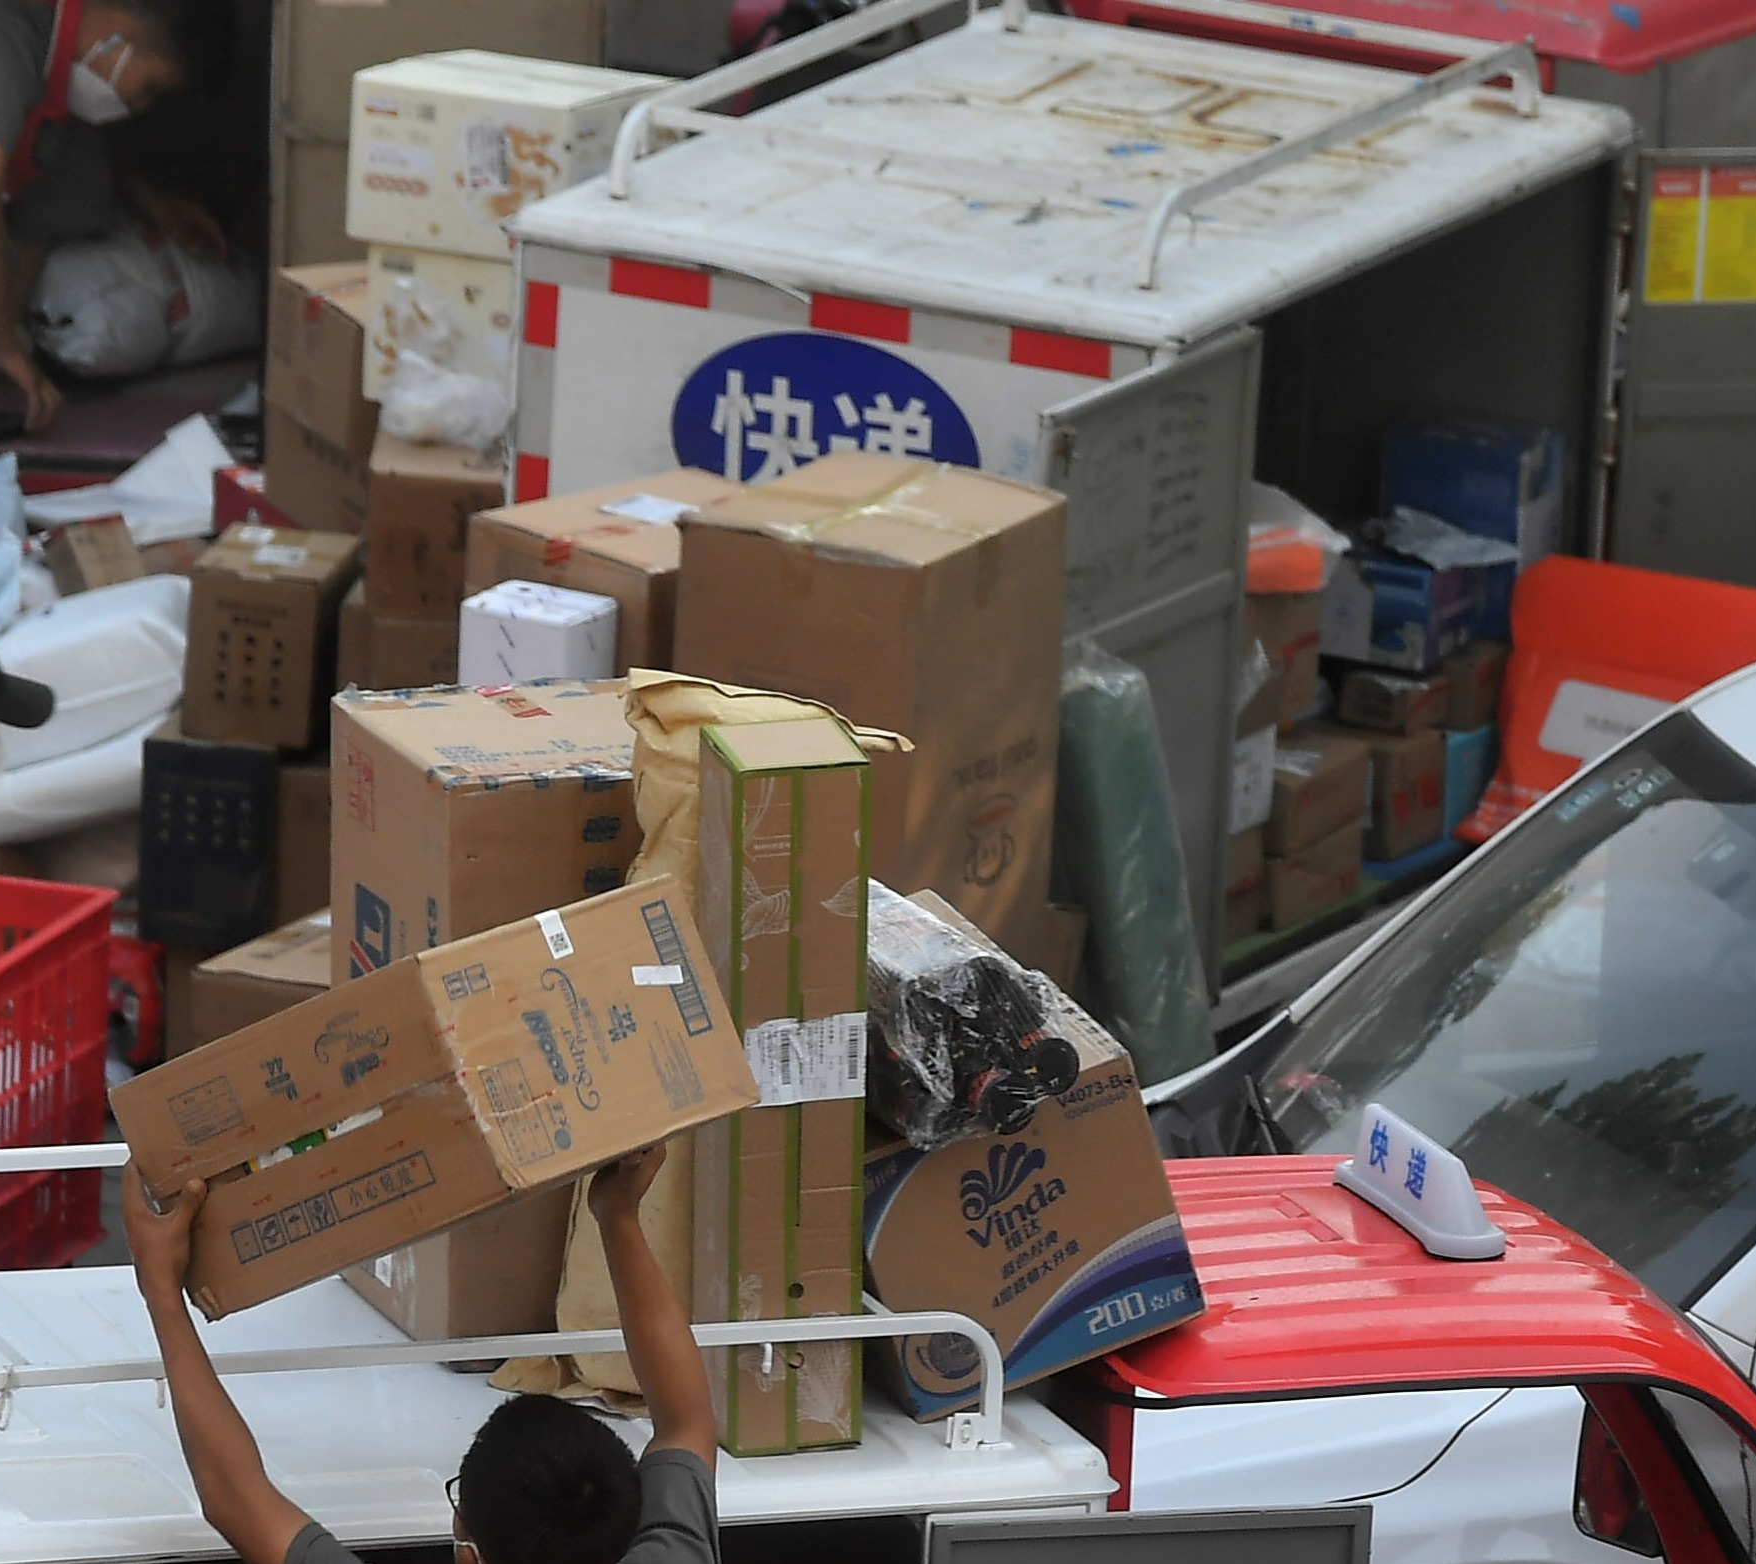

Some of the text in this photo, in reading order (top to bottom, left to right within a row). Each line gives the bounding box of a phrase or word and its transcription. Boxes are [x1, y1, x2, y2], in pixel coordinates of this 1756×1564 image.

[1367, 1119, 1432, 1203] 快递
[966, 1172, 1067, 1250] Vinda
[1087, 1292, 1145, 1336] 200
